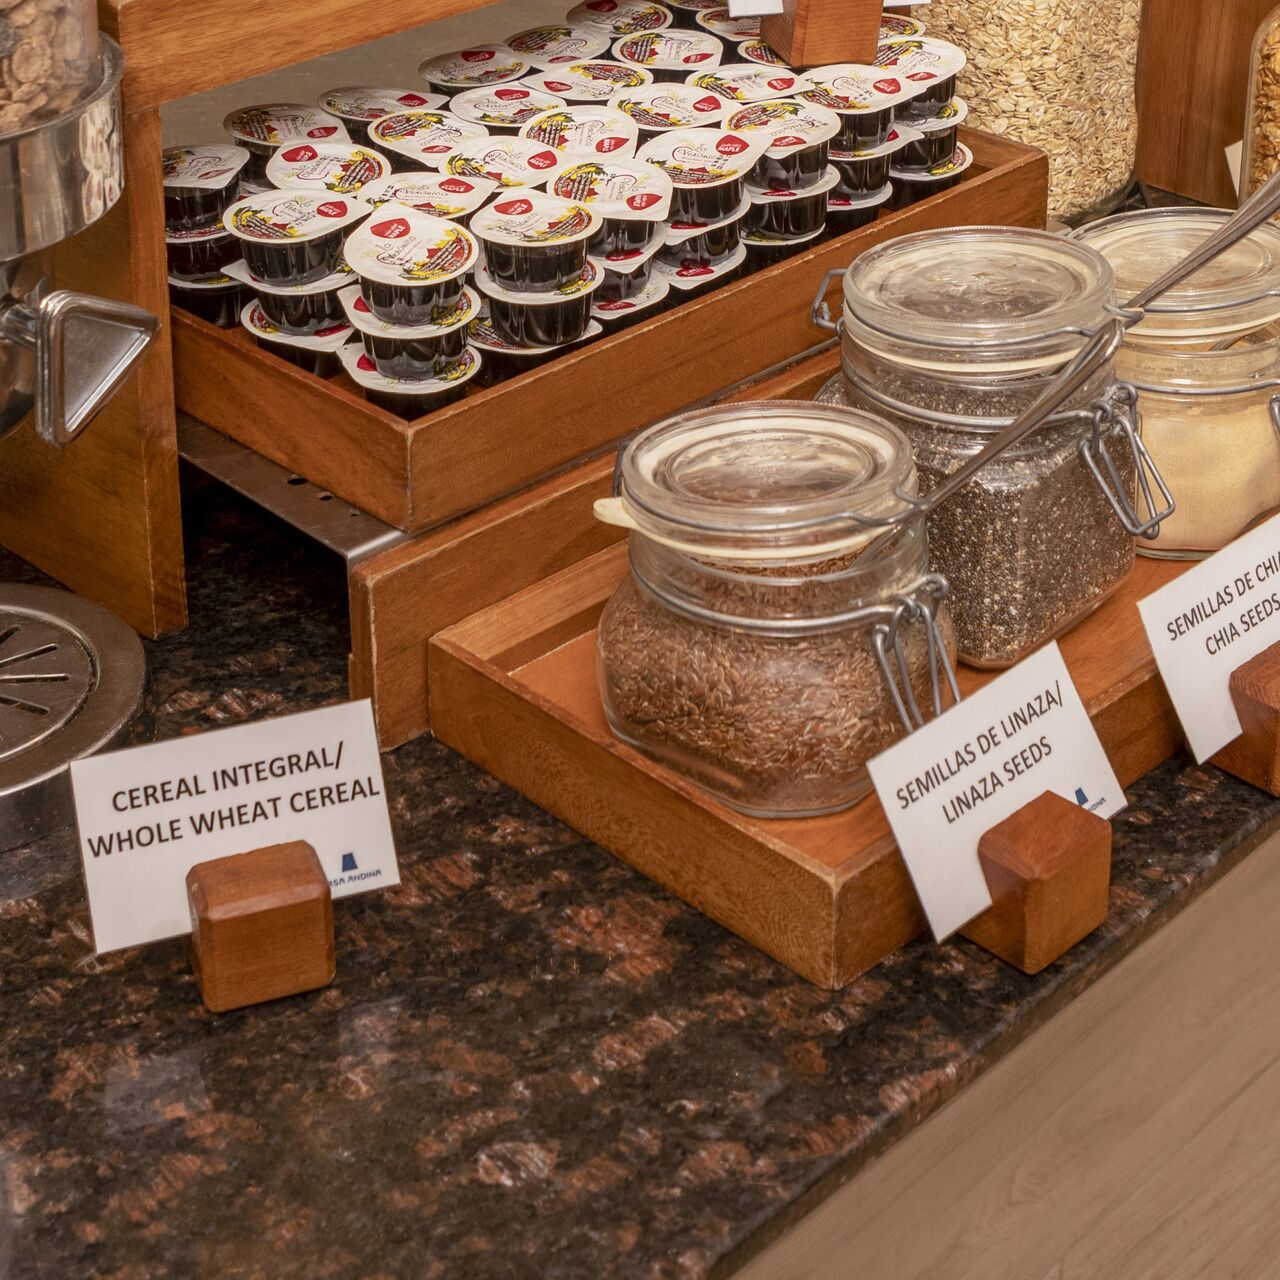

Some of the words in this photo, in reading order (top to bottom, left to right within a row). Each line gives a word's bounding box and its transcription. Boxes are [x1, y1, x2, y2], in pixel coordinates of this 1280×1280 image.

[1167, 585, 1234, 641] SEMILLAS
[1234, 571, 1255, 597] DE
[1205, 622, 1241, 656] CHIA
[112, 774, 206, 812] CEREAL
[212, 740, 344, 792] INTEGRAL/
[896, 743, 977, 810] SEMILLAS
[976, 726, 1002, 756] DE
[1000, 679, 1064, 739] LINAZA/
[942, 771, 1005, 824] LINAZA
[1003, 736, 1053, 782] SEEDS
[87, 819, 183, 858] WHOLE
[189, 797, 282, 835] WHEAT
[290, 776, 381, 813] CEREAL
[348, 869, 382, 885] ANDINA
